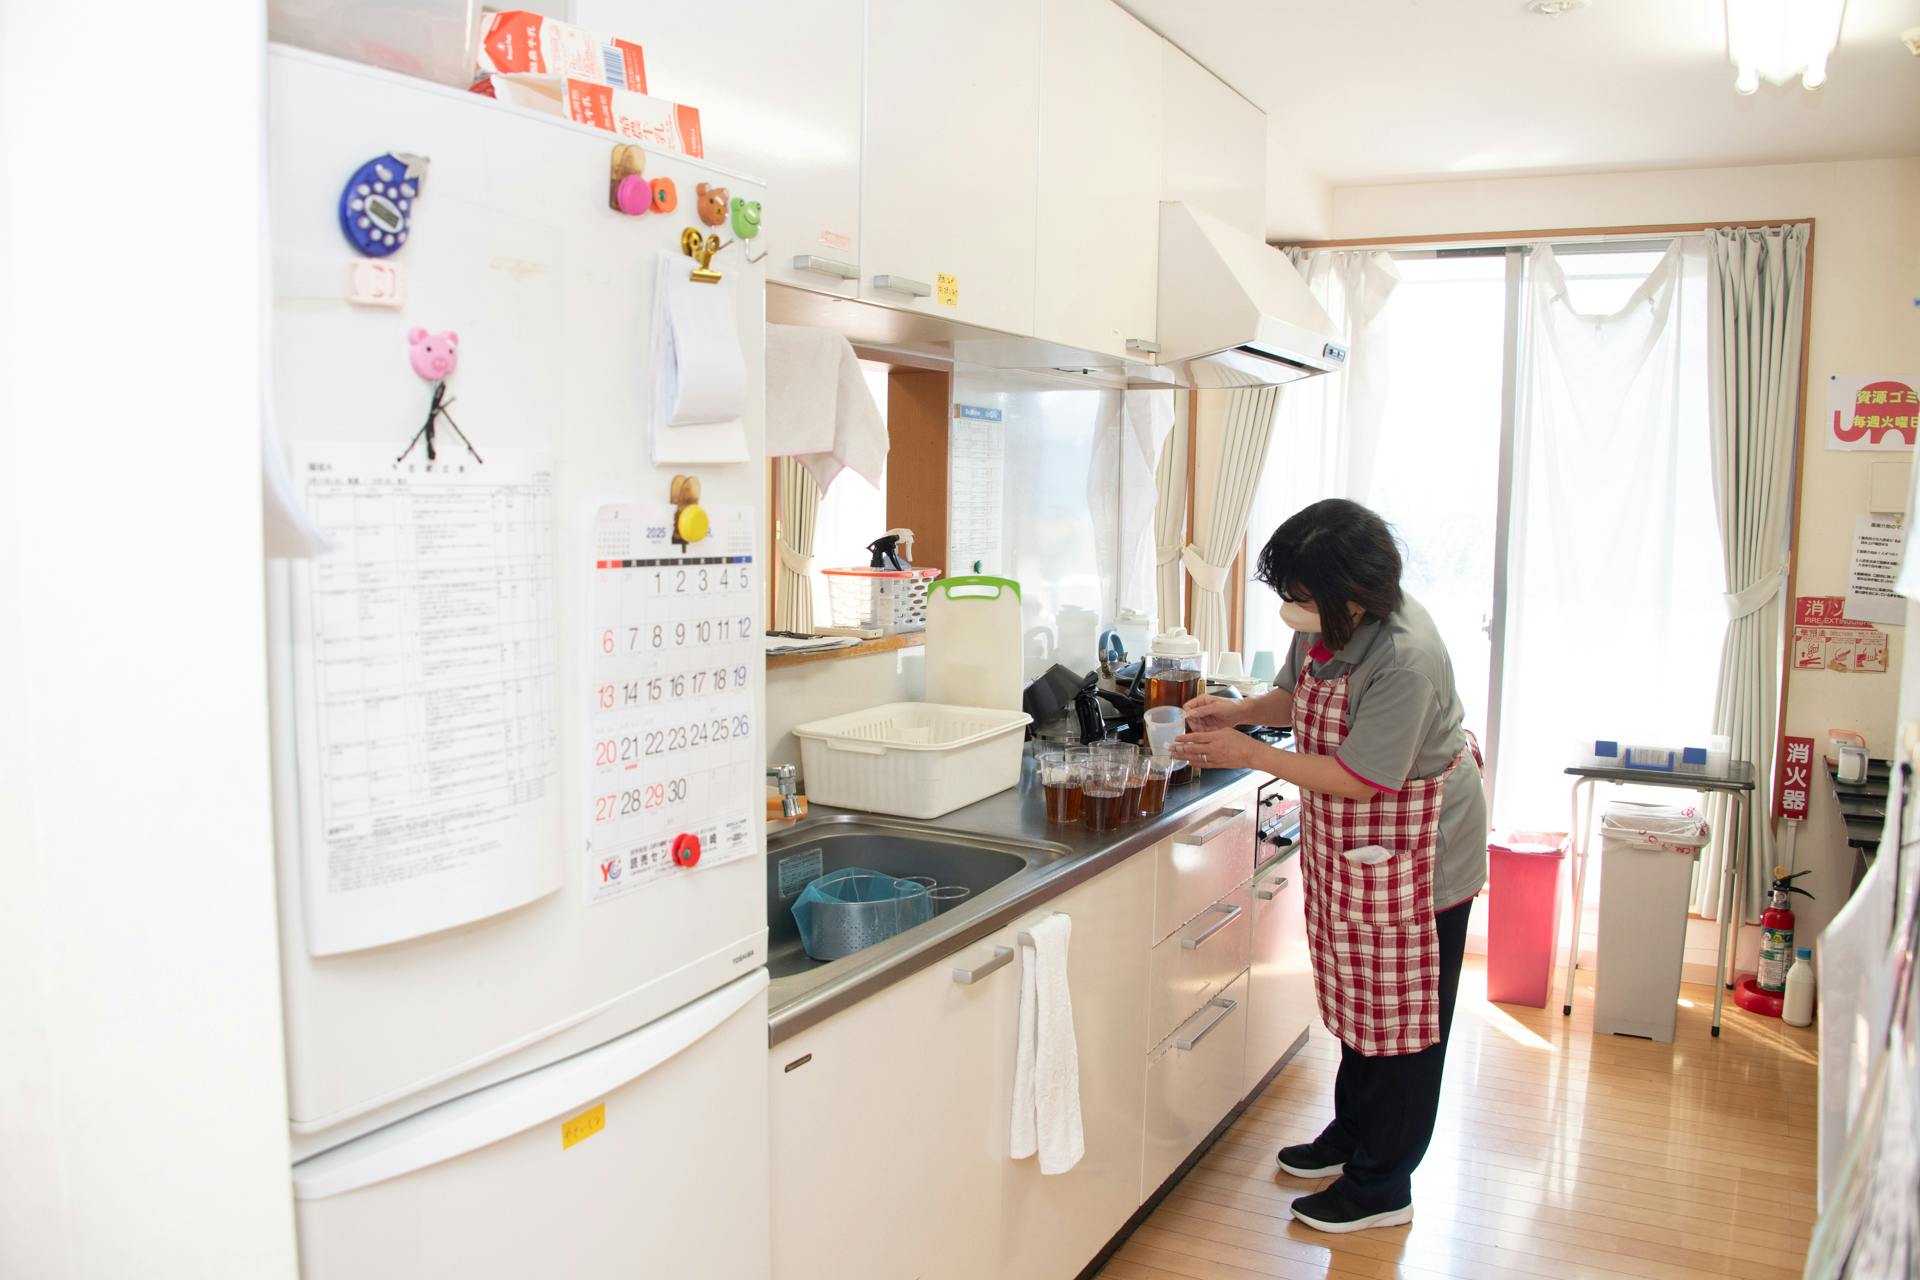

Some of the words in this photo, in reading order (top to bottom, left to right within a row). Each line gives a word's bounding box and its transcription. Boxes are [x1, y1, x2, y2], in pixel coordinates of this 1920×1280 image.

[1856, 390, 1918, 404] 資源ゴミ
[1854, 415, 1918, 428] 毎週火曜日
[646, 527, 666, 539] 2025
[655, 572, 661, 593] 1
[676, 570, 686, 593] 2
[698, 569, 708, 591] 3
[720, 569, 728, 589] 4
[740, 568, 749, 589] 5
[602, 629, 614, 654] 6
[629, 628, 639, 650] 7
[652, 625, 662, 648] 8
[675, 623, 685, 646] 9
[696, 621, 711, 643] 10
[717, 620, 730, 641] 11
[737, 617, 751, 638] 12
[1805, 617, 1821, 625] FIRE
[598, 684, 615, 709] 13
[623, 681, 638, 705] 14
[647, 678, 663, 701] 15
[669, 674, 685, 697] 16
[692, 671, 707, 694] 17
[713, 668, 727, 690] 18
[734, 666, 746, 687] 19
[596, 739, 617, 766] 20
[621, 736, 639, 761] 21
[645, 730, 664, 756] 22
[668, 726, 687, 751] 23
[691, 723, 708, 746] 24
[712, 718, 729, 742] 25
[732, 714, 750, 738] 26
[1782, 743, 1810, 811] 消火器
[595, 795, 617, 822] 27
[621, 789, 641, 815] 28
[645, 783, 665, 809] 29
[667, 778, 687, 803] 30
